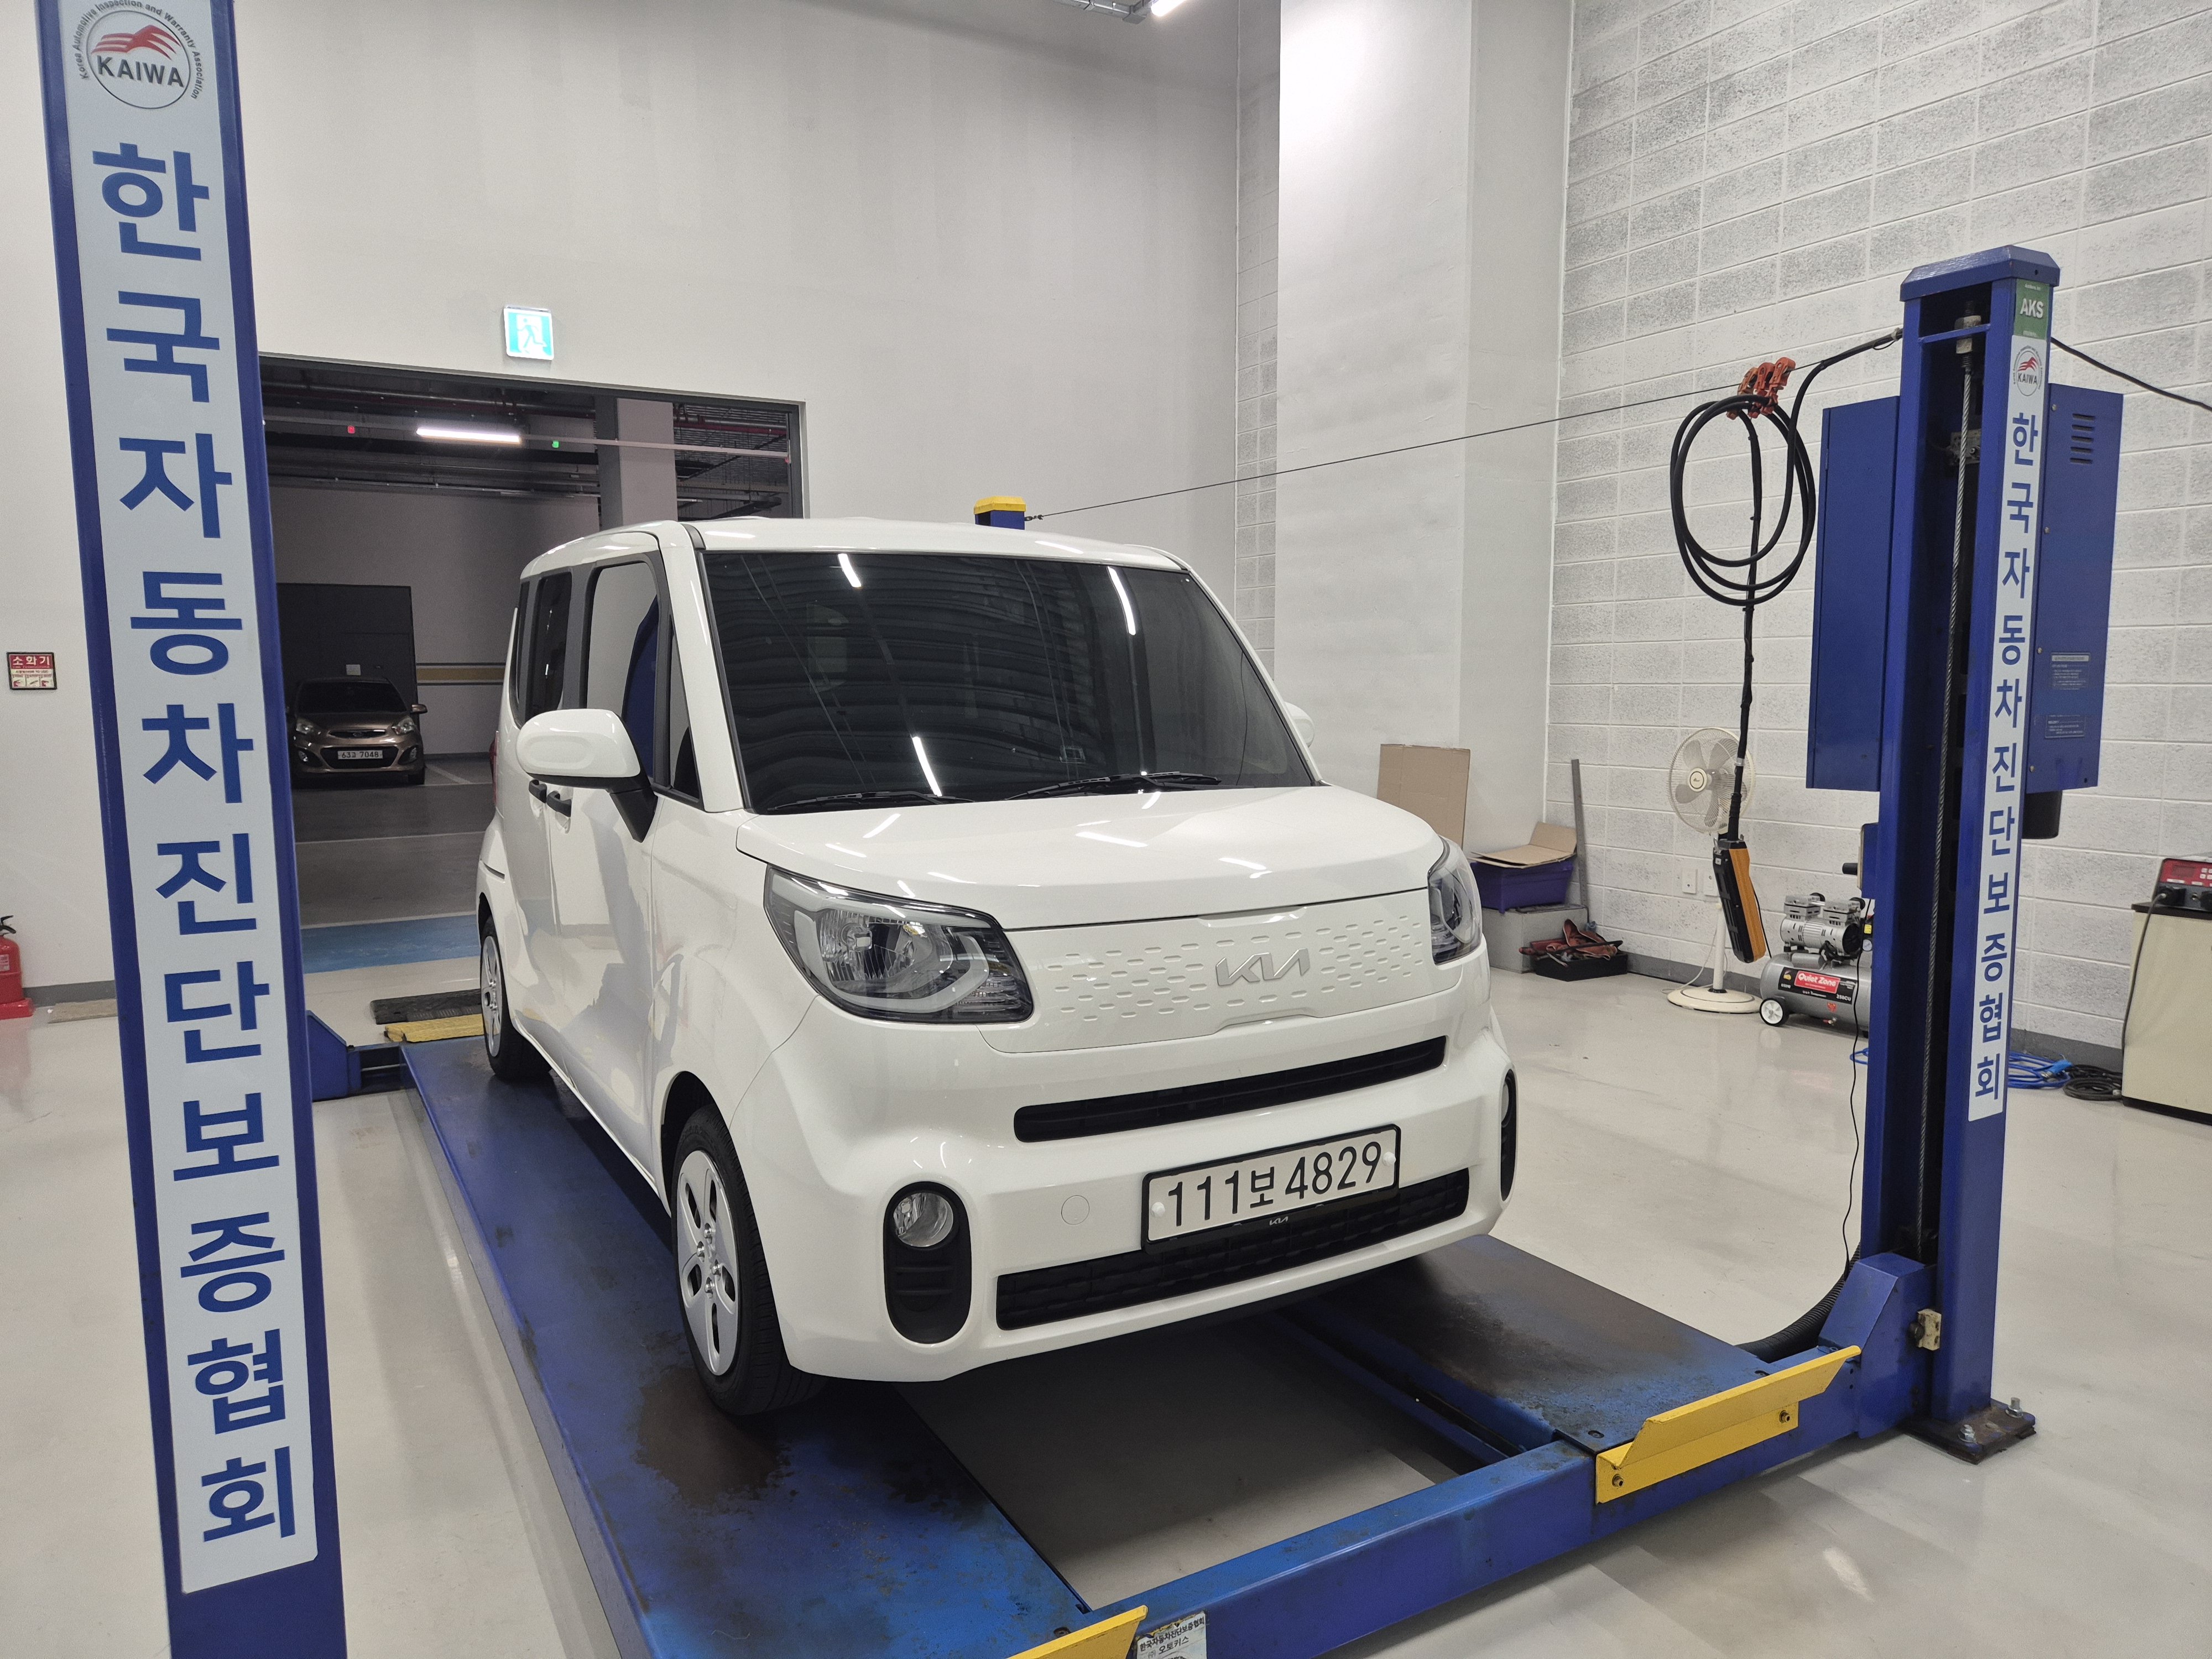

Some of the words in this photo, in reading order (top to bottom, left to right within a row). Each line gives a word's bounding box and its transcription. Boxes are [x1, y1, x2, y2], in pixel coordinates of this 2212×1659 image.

[95, 0, 143, 12] Inspection
[145, 4, 162, 15] and
[72, 9, 97, 51] Automotive
[164, 13, 196, 49] Warranty
[75, 53, 88, 79] Korea
[97, 55, 184, 87] KAIWA
[191, 51, 204, 99] Association
[2020, 298, 2043, 319] AKS
[2018, 373, 2037, 385] KAIWA
[1975, 413, 2038, 1099] 한국자동차진단보증협회
[92, 143, 295, 1543] 한국자동차진단보증협회
[1215, 948, 1310, 986] KIA
[1798, 973, 1818, 982] Quiet
[1819, 977, 1837, 987] Zone
[1140, 1616, 1204, 1652] 한국자동차진단보증협회
[1159, 1636, 1189, 1655] 오토키스
